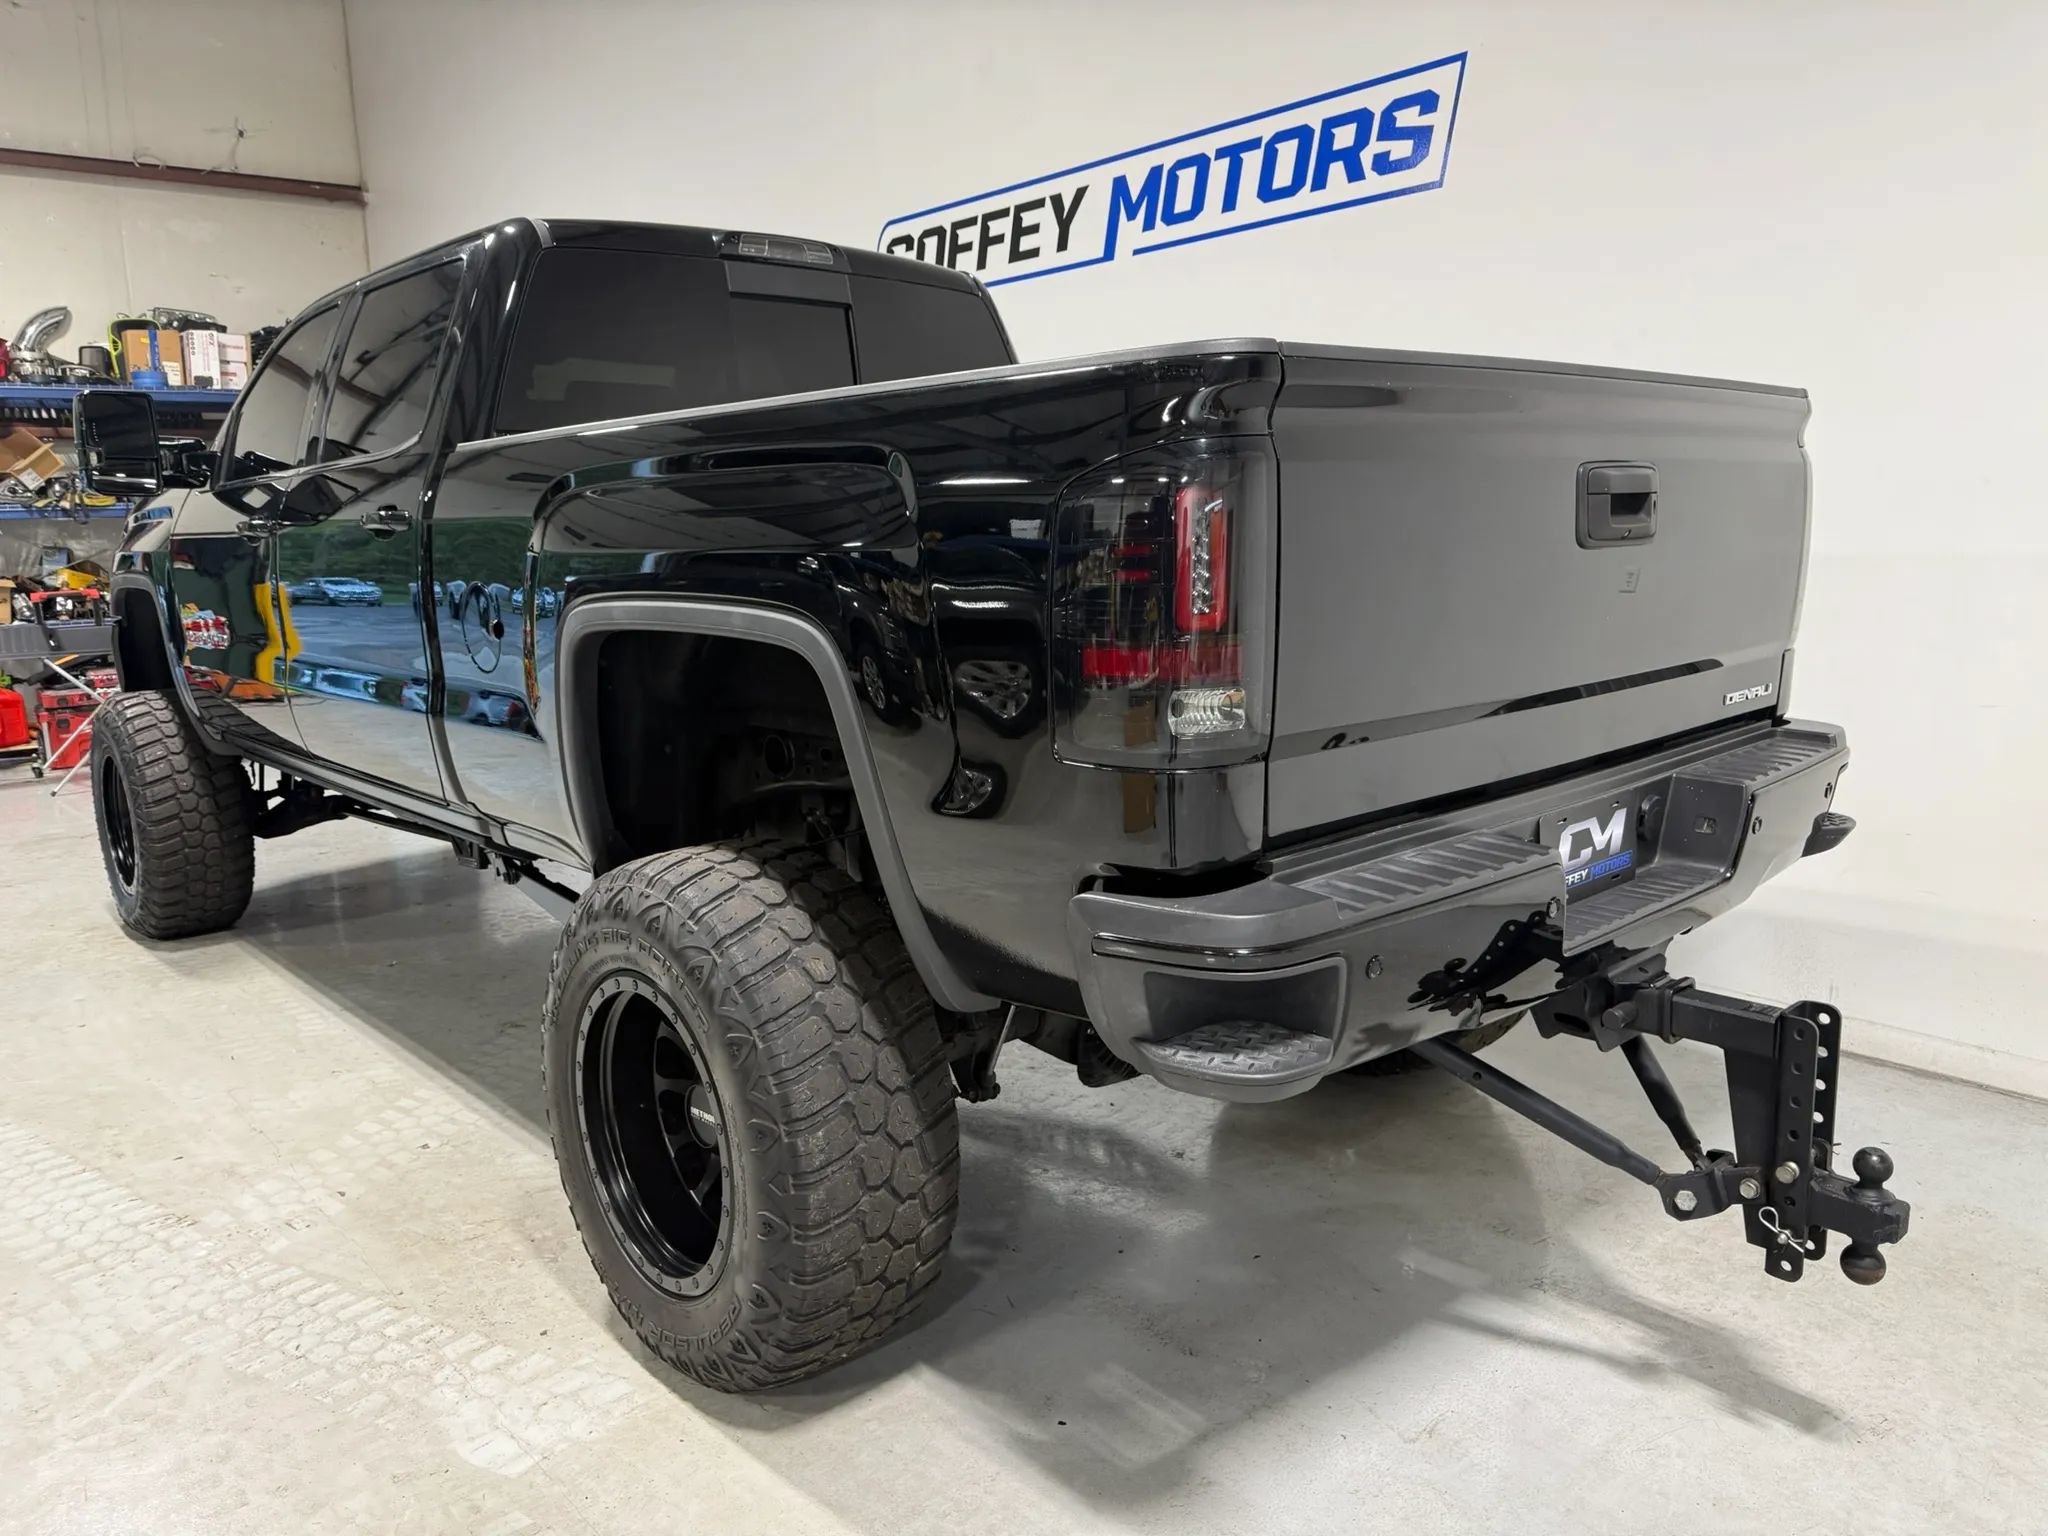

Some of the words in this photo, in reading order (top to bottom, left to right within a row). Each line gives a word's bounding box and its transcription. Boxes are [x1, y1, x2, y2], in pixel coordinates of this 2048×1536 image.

[1103, 88, 1440, 261] MOTORS
[1723, 682, 1772, 706] DENALI
[1559, 807, 1627, 868] CM
[1590, 853, 1631, 878] MOTORS
